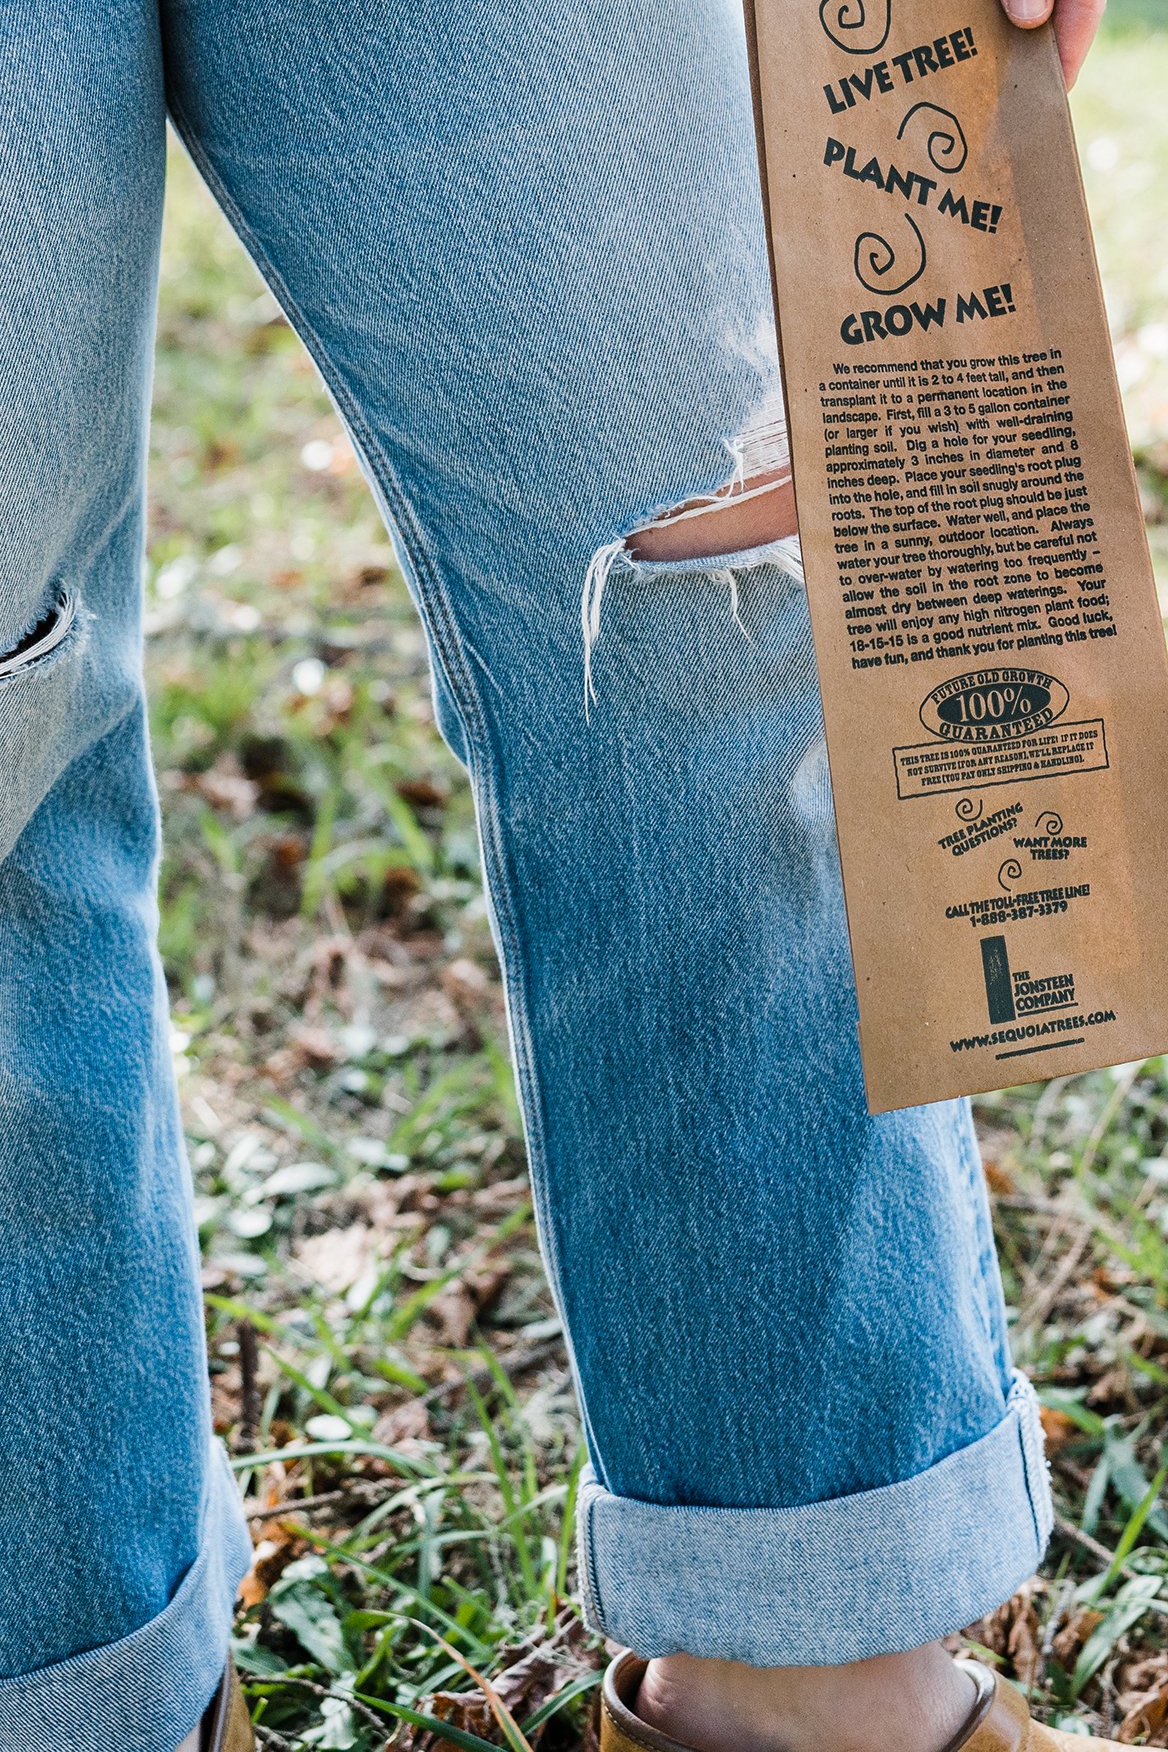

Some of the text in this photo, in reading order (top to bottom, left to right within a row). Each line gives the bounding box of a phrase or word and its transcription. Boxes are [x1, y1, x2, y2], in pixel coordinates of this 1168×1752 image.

[823, 27, 978, 114] LIVE TREE!
[823, 137, 1003, 234] PLANT ME!
[840, 283, 1016, 345] GROW ME!
[832, 348, 1062, 374] We recommend that you grow this tree in
[819, 379, 1067, 408] transplant it to a permanent location in the
[823, 427, 839, 442] (or
[845, 427, 878, 440] larger
[884, 424, 892, 436] if
[898, 425, 921, 438] you
[965, 416, 990, 430] with
[995, 410, 1073, 428] well-draining
[824, 426, 1076, 458] planting soil. Dig a hole for your seedling,
[826, 456, 1081, 489] inches deep. Place your seedling's root plug
[832, 498, 1090, 537] below the surface. Water well, and place the
[836, 530, 1097, 570] water your tree thoroughly, but be careful not
[841, 561, 1103, 602] allow the soil in the root zone to become
[844, 578, 1106, 619] almost dry between deep waterings. Your
[846, 592, 1110, 635] tree will enjoy any high nitrogen plant food;
[849, 609, 1113, 652] 18-15-15 is a good nutrient mix. Good luck,
[851, 623, 1117, 669] have fun, and thank you for planting this tree!
[931, 671, 1053, 705] FUTURE OLD GROWTH
[956, 685, 1031, 722] 100%
[939, 707, 1054, 740] GUARANTEED
[901, 756, 918, 766] THIS
[920, 753, 939, 762] TREE
[941, 752, 949, 761] IS
[950, 749, 970, 758] 100%
[972, 741, 1021, 755] GUARANTEED
[1022, 738, 1038, 748] FOR
[1070, 733, 1077, 741] IT
[1079, 730, 1098, 740] DOES
[907, 767, 923, 777] NOT
[924, 762, 956, 774] SURVIVE
[978, 756, 993, 766] ANY
[1052, 744, 1085, 755] REPLACE
[1086, 742, 1094, 750] IT
[921, 776, 940, 786] FREE
[961, 771, 975, 780] PAY
[976, 768, 995, 777] ONLY
[997, 762, 1032, 774] SHIPPING
[938, 802, 1023, 849] TREE PLANTING
[952, 818, 1017, 856] QUESTIONS?
[1013, 837, 1087, 848] WANT MORE
[1030, 849, 1070, 860] TREES?
[946, 884, 1090, 918] CALL THE TOLL-FREE TREE LINE!
[970, 901, 1068, 927] 1-888-387-3379
[1012, 971, 1030, 982] THE
[1014, 974, 1074, 997] JONSTEEN
[1015, 988, 1075, 1011] COMPANY
[950, 1010, 1116, 1052] WWW.SEQUOIATREES.COM
